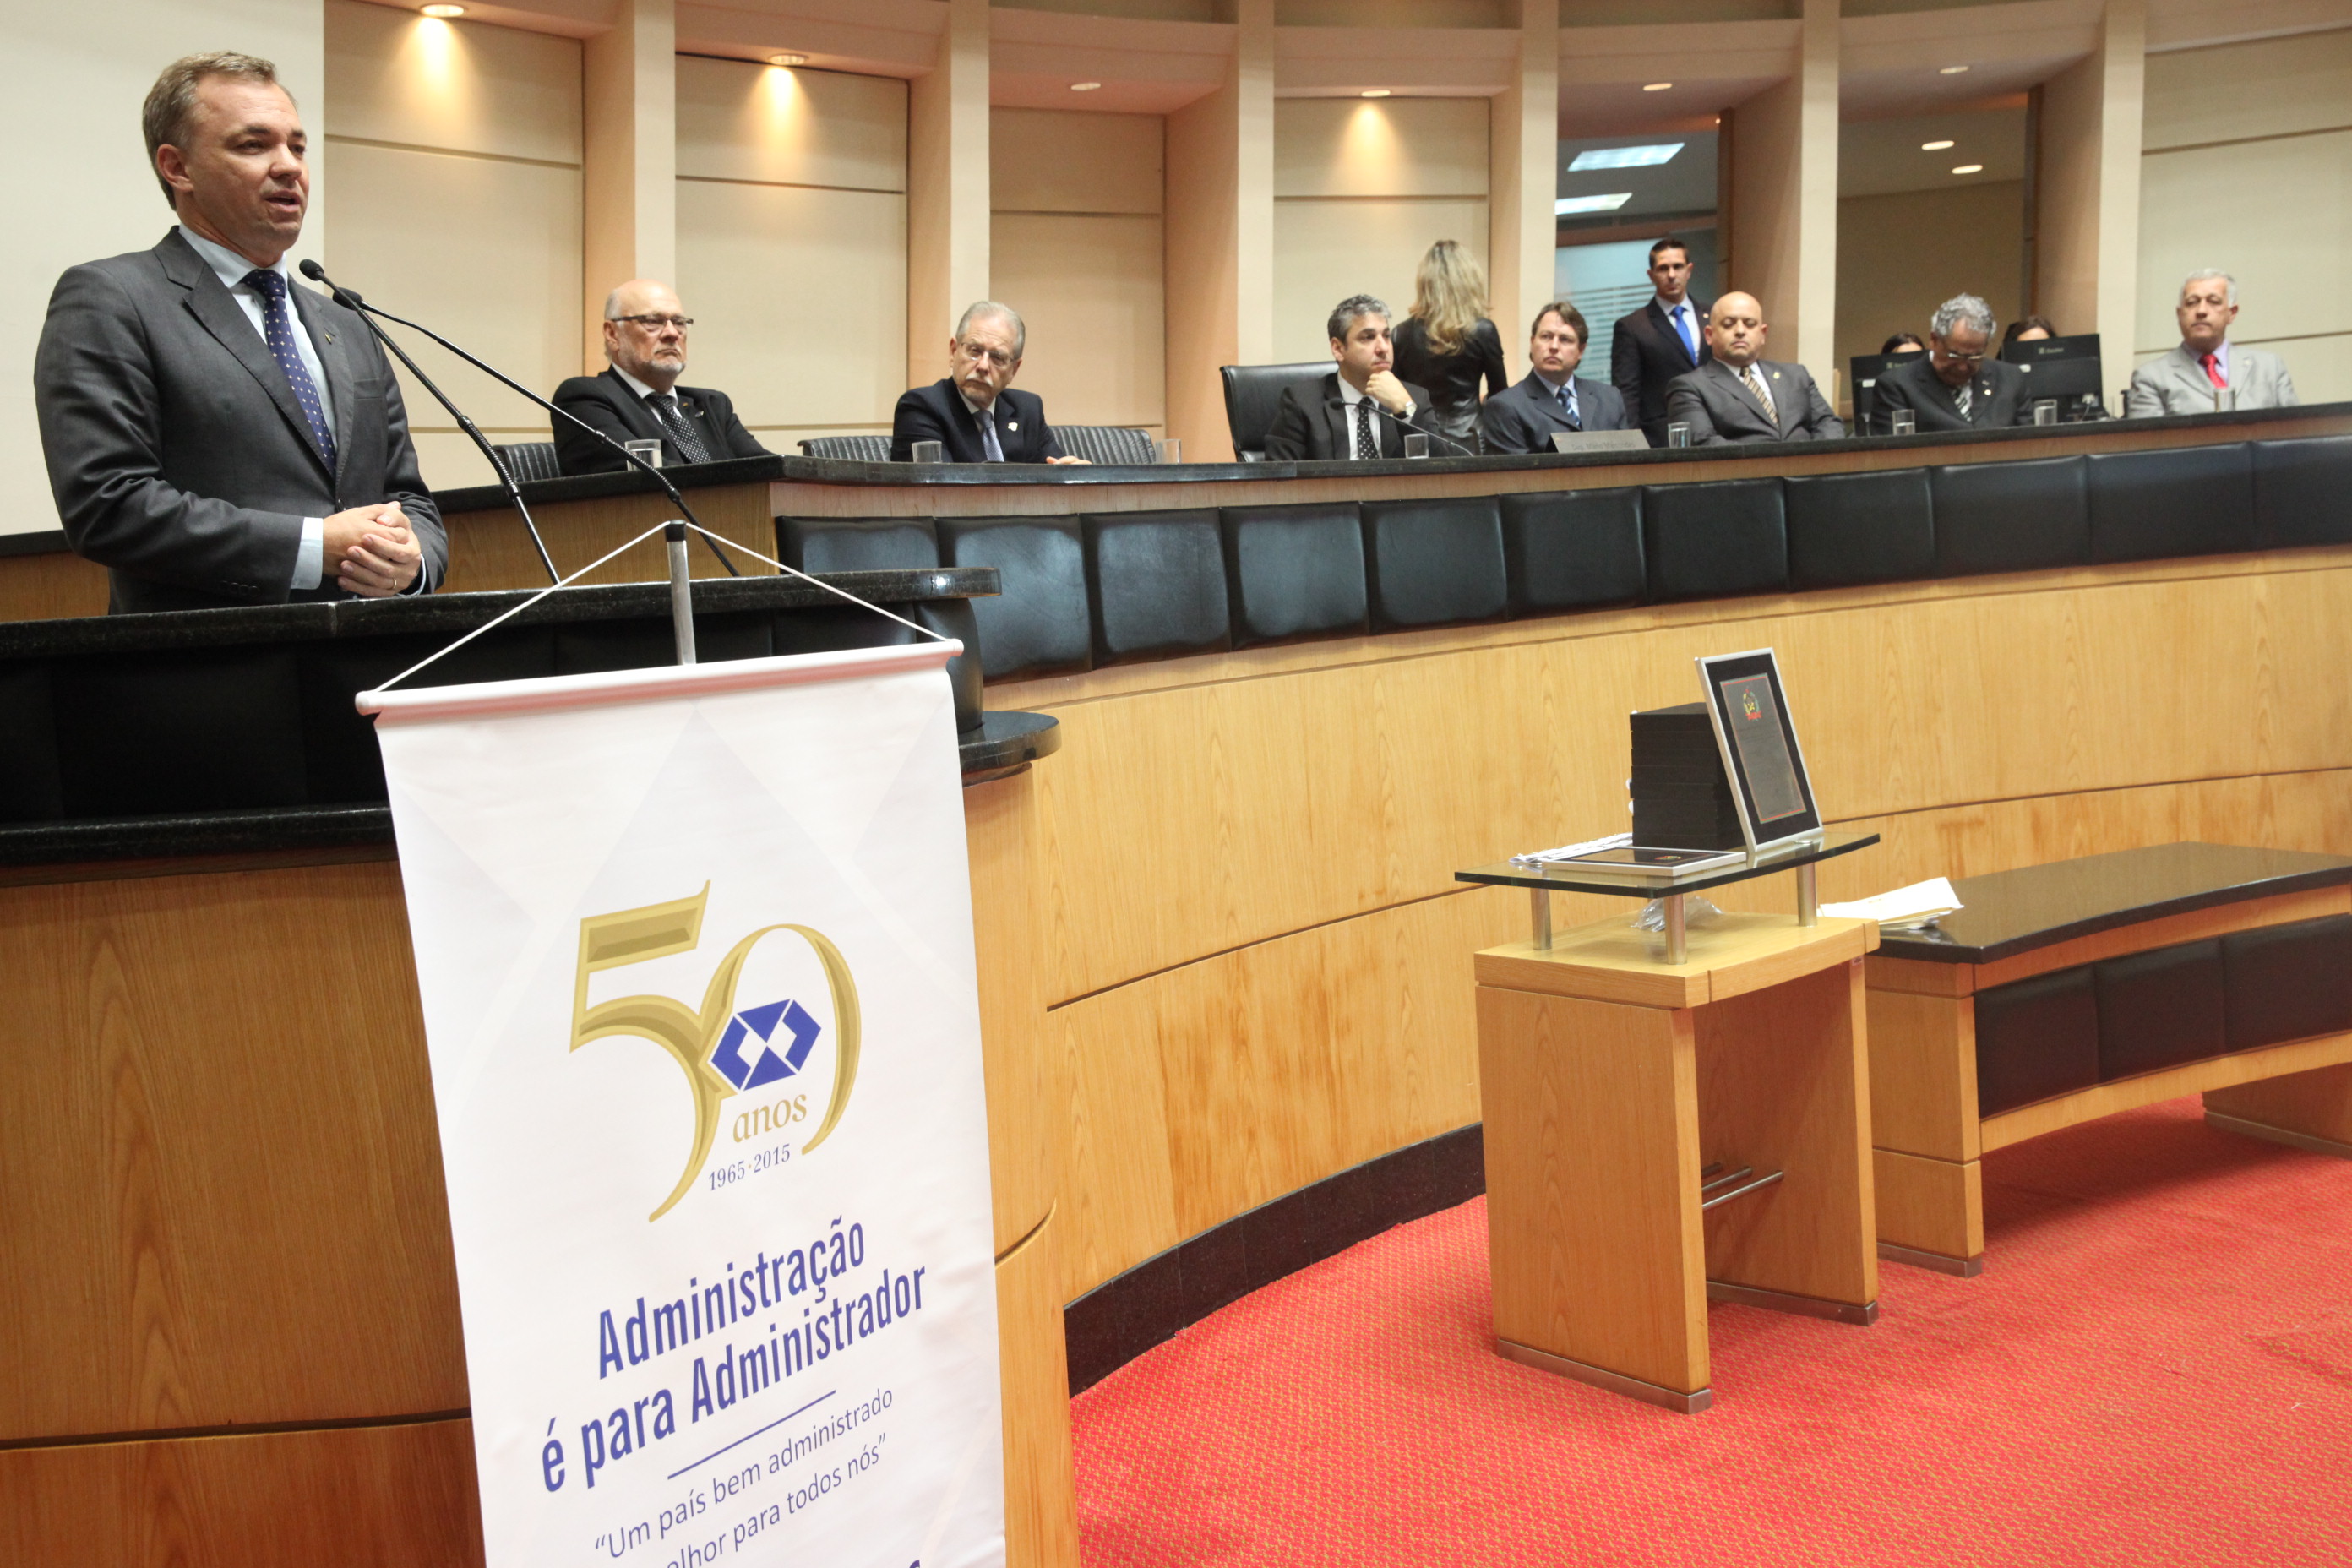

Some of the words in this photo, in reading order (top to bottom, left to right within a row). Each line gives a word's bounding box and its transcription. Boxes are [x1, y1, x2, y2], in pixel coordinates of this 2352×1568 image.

[569, 879, 862, 1222] 50
[732, 1094, 808, 1142] anos
[598, 1216, 865, 1380] Administração
[542, 1417, 567, 1493] é
[580, 1388, 677, 1489] para
[691, 1266, 926, 1424] Administrador
[659, 1490, 706, 1540] país
[713, 1461, 761, 1505] bem
[768, 1387, 893, 1476] administrado
[733, 1500, 781, 1551] para
[786, 1473, 842, 1515] todos
